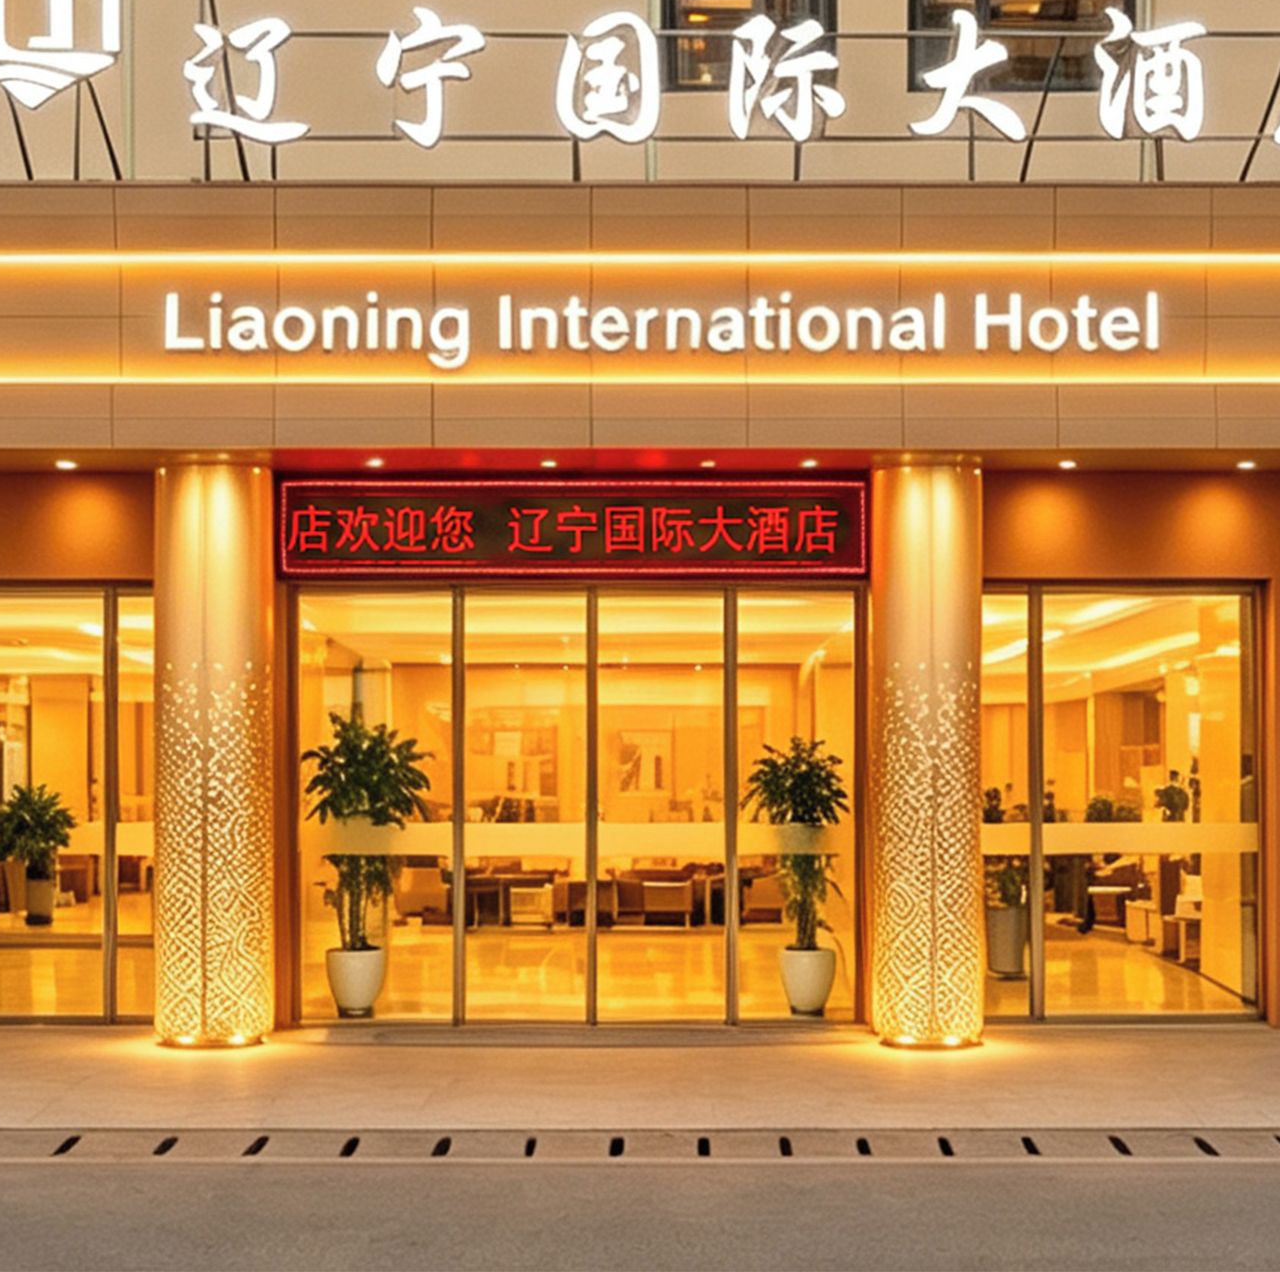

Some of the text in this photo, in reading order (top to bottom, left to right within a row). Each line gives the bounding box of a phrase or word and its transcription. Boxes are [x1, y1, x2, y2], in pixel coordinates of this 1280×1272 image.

[163, 290, 1160, 369] Liaoning International Hotel
[287, 504, 839, 554] 店欢迎您 辽宁国际大酒店
